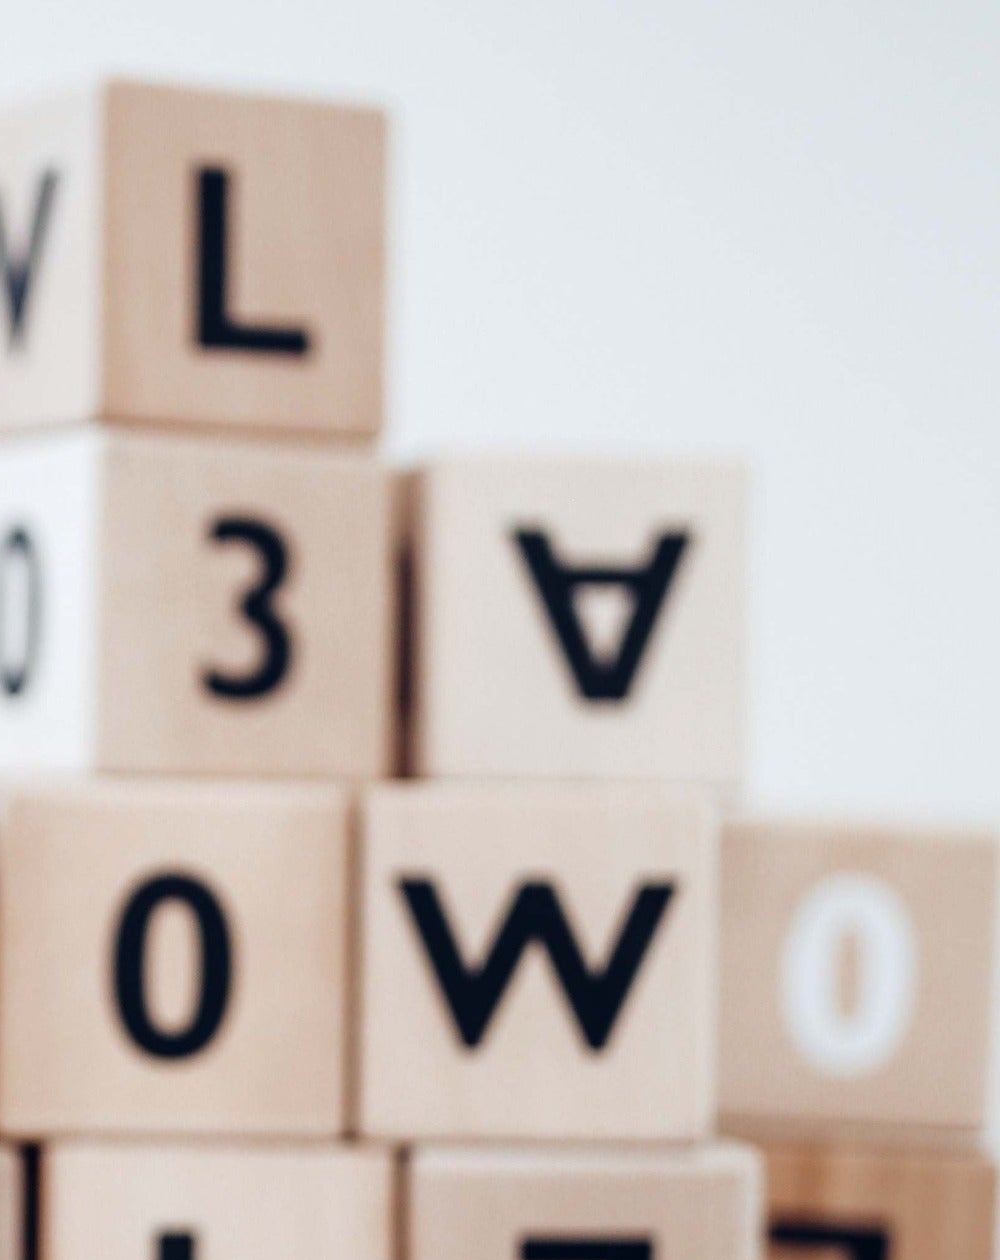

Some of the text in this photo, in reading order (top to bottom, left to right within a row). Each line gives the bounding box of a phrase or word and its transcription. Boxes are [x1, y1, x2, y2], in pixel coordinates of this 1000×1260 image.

[192, 165, 312, 360] L
[201, 515, 295, 704] 3
[511, 526, 692, 707] A
[396, 875, 676, 1055] W
